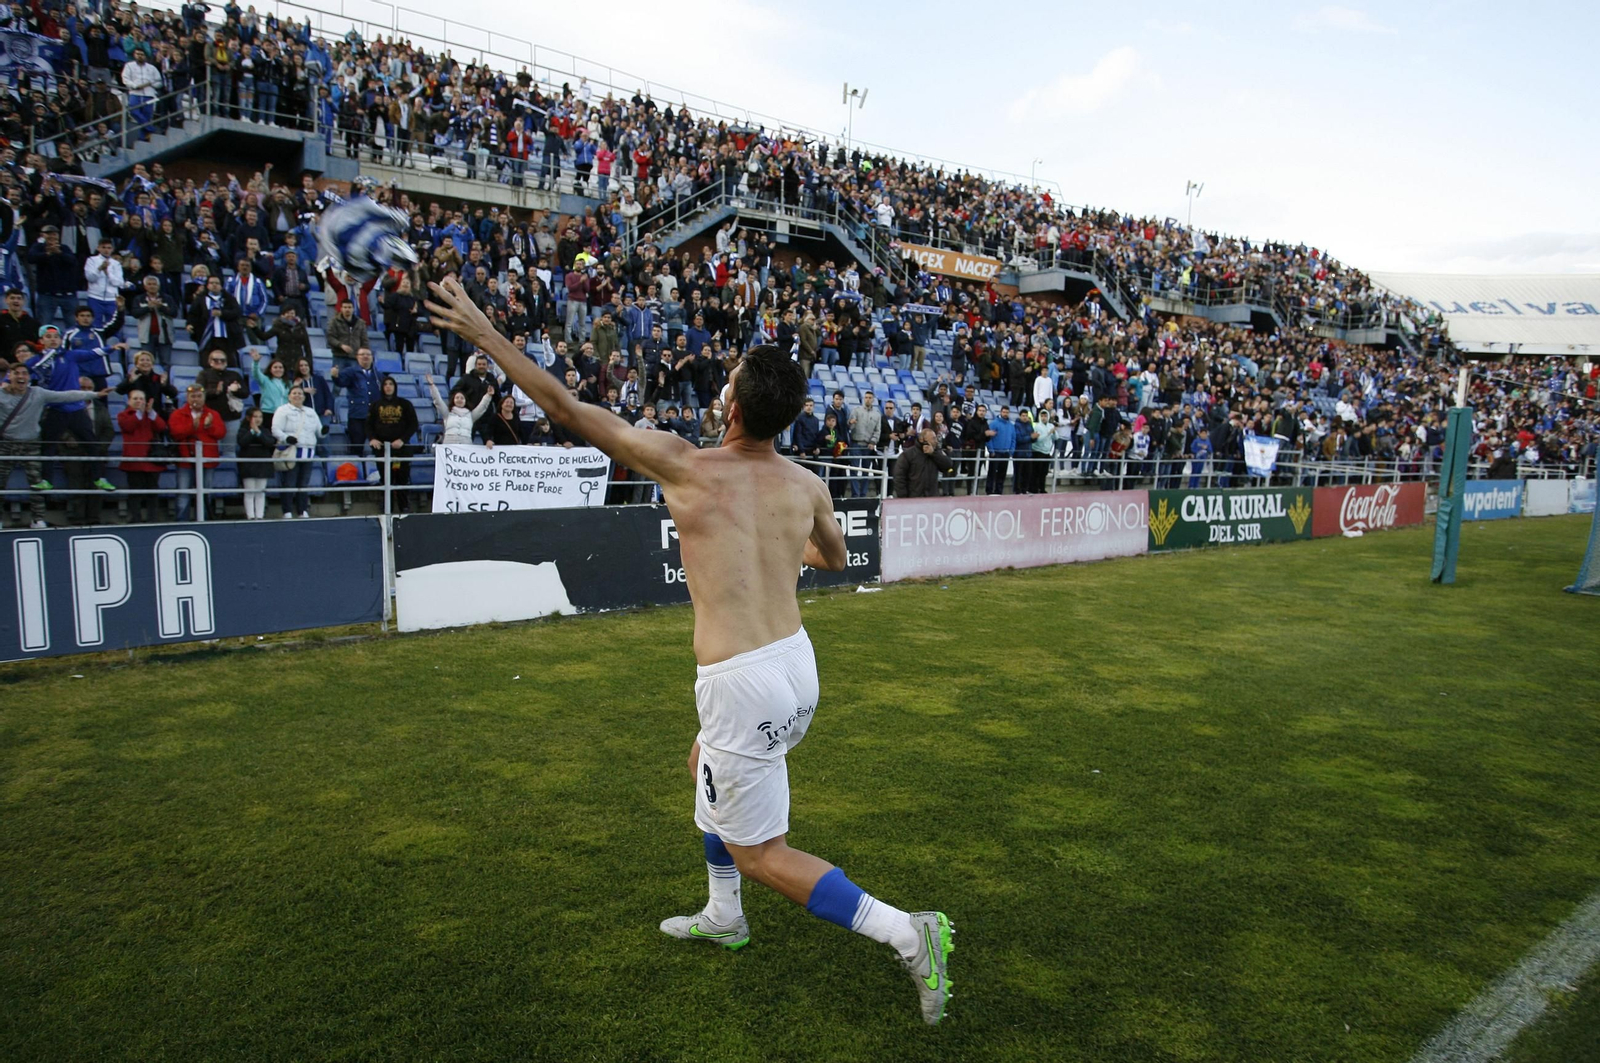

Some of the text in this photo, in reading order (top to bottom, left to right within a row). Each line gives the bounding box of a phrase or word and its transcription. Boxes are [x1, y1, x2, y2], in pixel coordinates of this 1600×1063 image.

[954, 257, 998, 278] NACEX
[469, 452, 496, 464] CLUB
[558, 455, 571, 465] DE
[572, 454, 604, 464] HUELVA
[446, 464, 480, 477] DECANO
[483, 468, 499, 477] DEL
[534, 468, 572, 479] ESPAÑOL
[488, 481, 502, 492] SE
[505, 479, 535, 493] PUEDE
[1040, 502, 1147, 537] FERRONOL
[1181, 493, 1287, 523] CAJA RURAL
[885, 508, 1025, 549] FERRONOL
[1208, 523, 1262, 543] DEL SUR
[13, 530, 215, 652] IPA
[703, 763, 717, 803] 3
